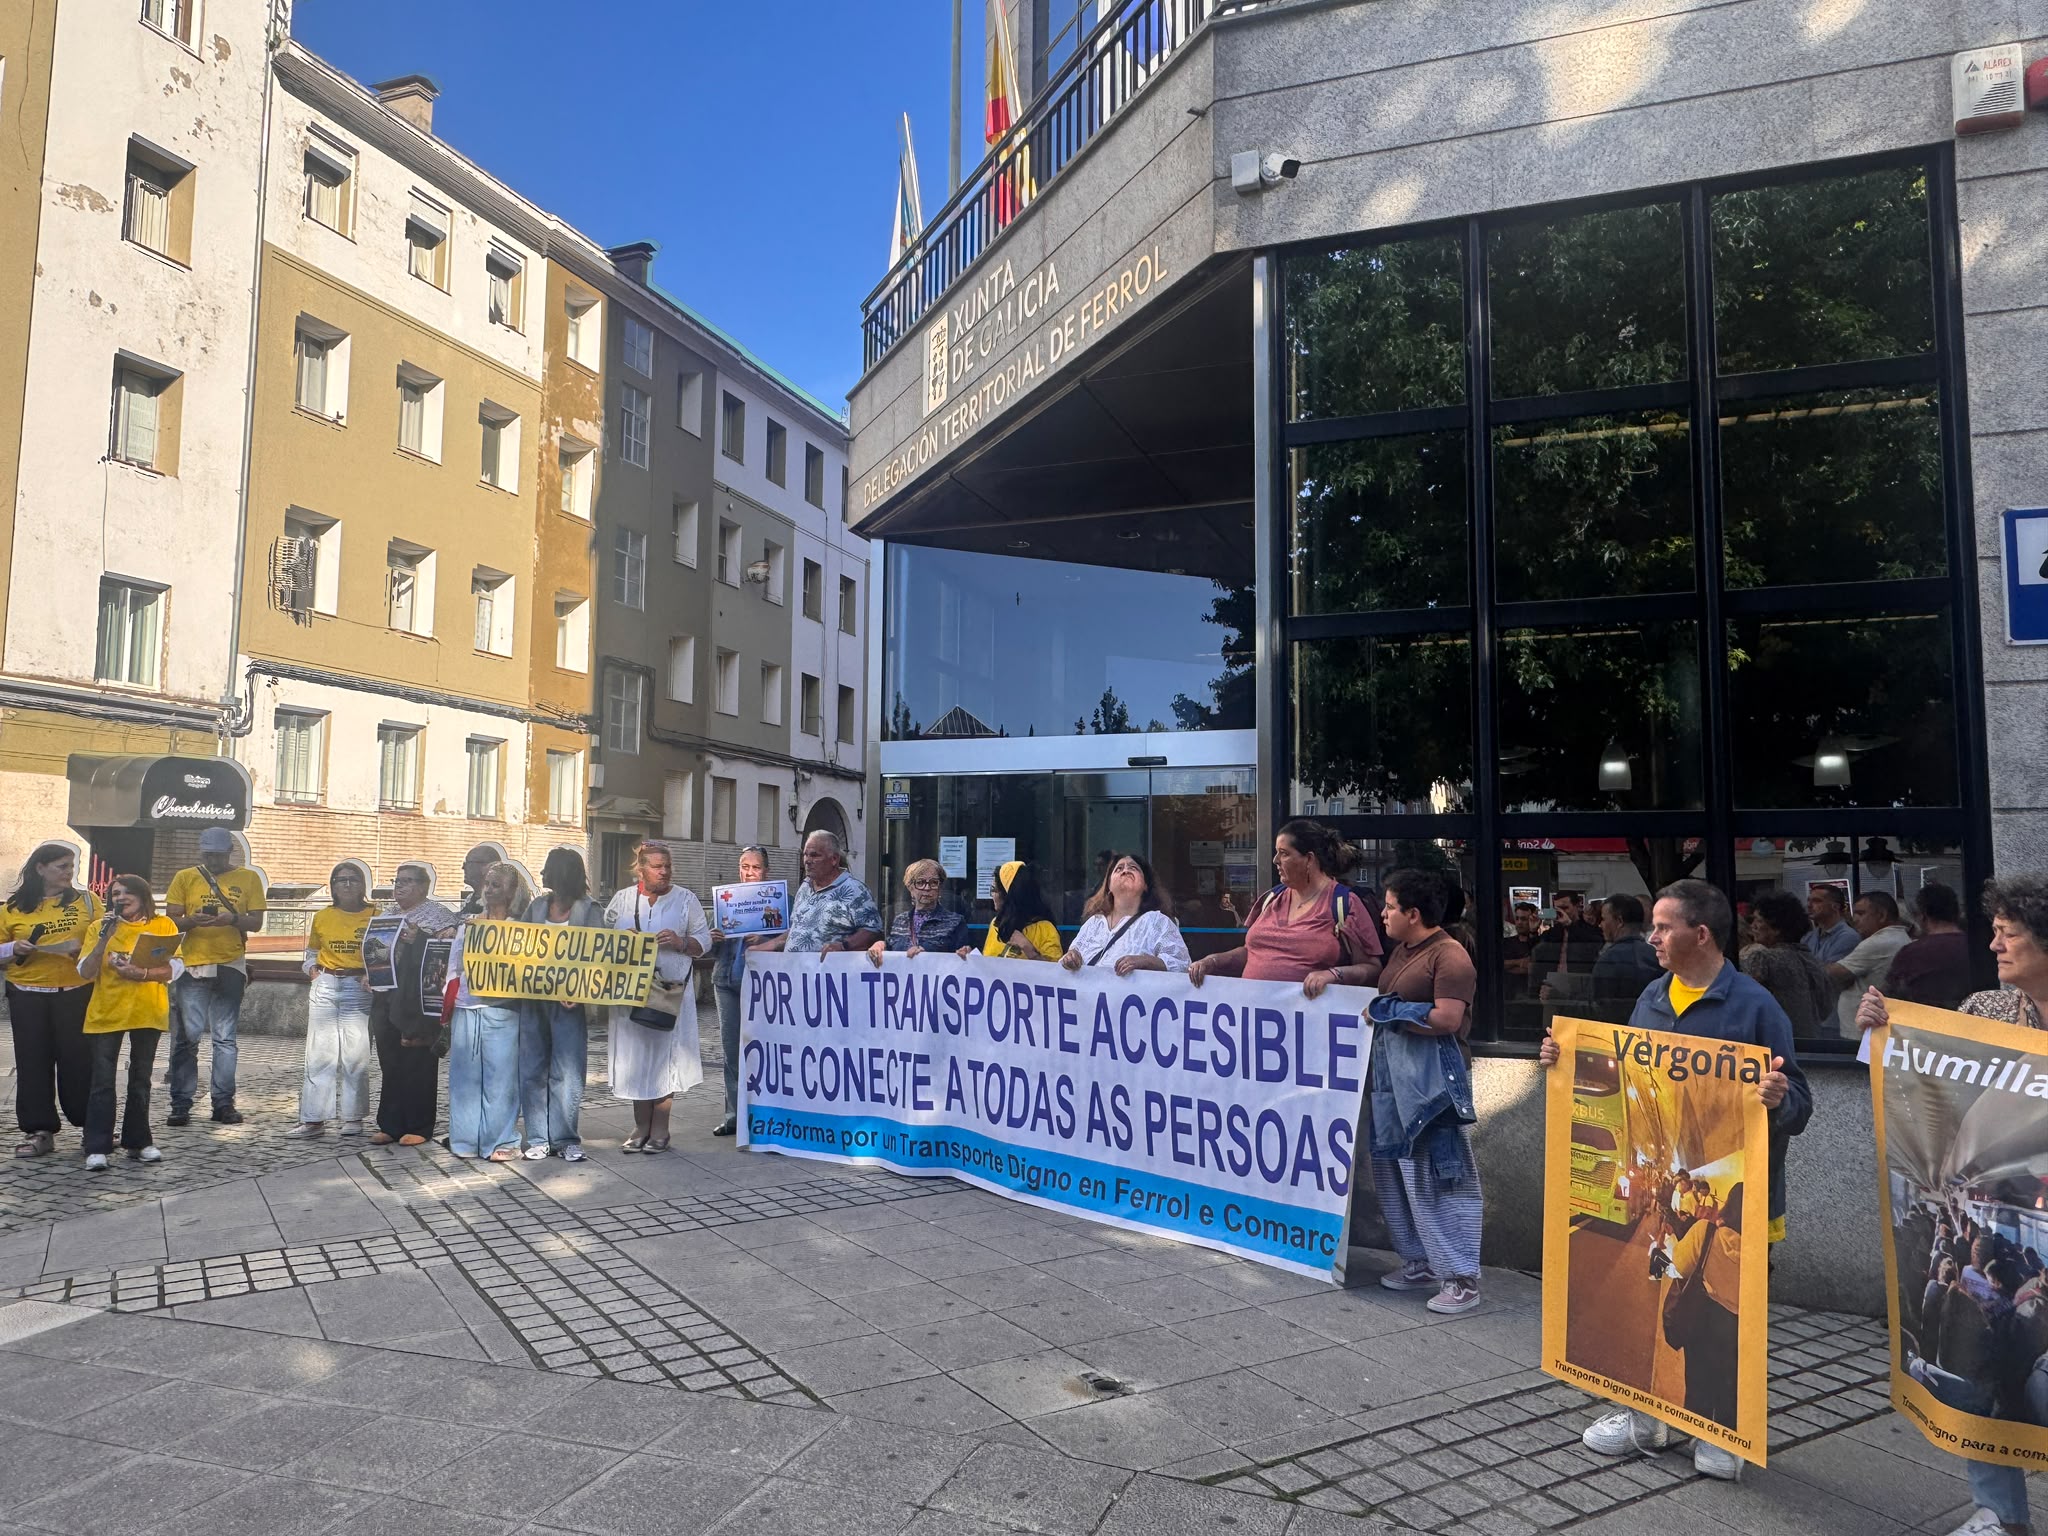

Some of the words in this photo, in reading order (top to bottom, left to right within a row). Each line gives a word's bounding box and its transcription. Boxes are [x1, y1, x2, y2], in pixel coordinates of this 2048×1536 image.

[952, 336, 974, 384] DE
[980, 262, 1060, 358] GALICIA
[953, 259, 1015, 342] XUNTA
[864, 424, 938, 509] DELEGACIÓN
[941, 343, 1045, 446] TERRITORIAL
[1050, 314, 1075, 364] DE
[1080, 245, 1168, 340] FERROL
[466, 960, 517, 993] XUNTA
[521, 964, 649, 1001] RESPONSABLE
[467, 924, 550, 959] MONBUS
[554, 930, 655, 967] CULPABLE
[748, 970, 796, 1026] POR
[802, 972, 849, 1028] UN
[861, 972, 1080, 1054] TRANSPORTE
[1090, 991, 1359, 1093] ACCESIBLE
[744, 1039, 794, 1097] QUE
[800, 1045, 934, 1111] CONECTE
[1086, 1080, 1133, 1152] AS
[1145, 1089, 1353, 1197] PERSOAS
[748, 1113, 836, 1145] lataforma
[841, 1129, 878, 1151] por
[882, 1130, 897, 1151] un
[900, 1132, 1004, 1173] Transporte
[1008, 1153, 1072, 1191] Digno
[1078, 1175, 1106, 1200] en
[1114, 1177, 1190, 1220] Ferrol
[1199, 1203, 1215, 1226] e
[1223, 1203, 1340, 1257] Comarc
[1554, 1359, 1601, 1386] Transporte
[1602, 1379, 1631, 1398] Digno
[1633, 1392, 1655, 1408] para
[1656, 1400, 1663, 1411] a
[1664, 1405, 1705, 1429] comarca
[1707, 1423, 1720, 1436] de
[1721, 1431, 1752, 1450] Ferrol
[1960, 1437, 1996, 1454] para
[1999, 1445, 2009, 1456] a
